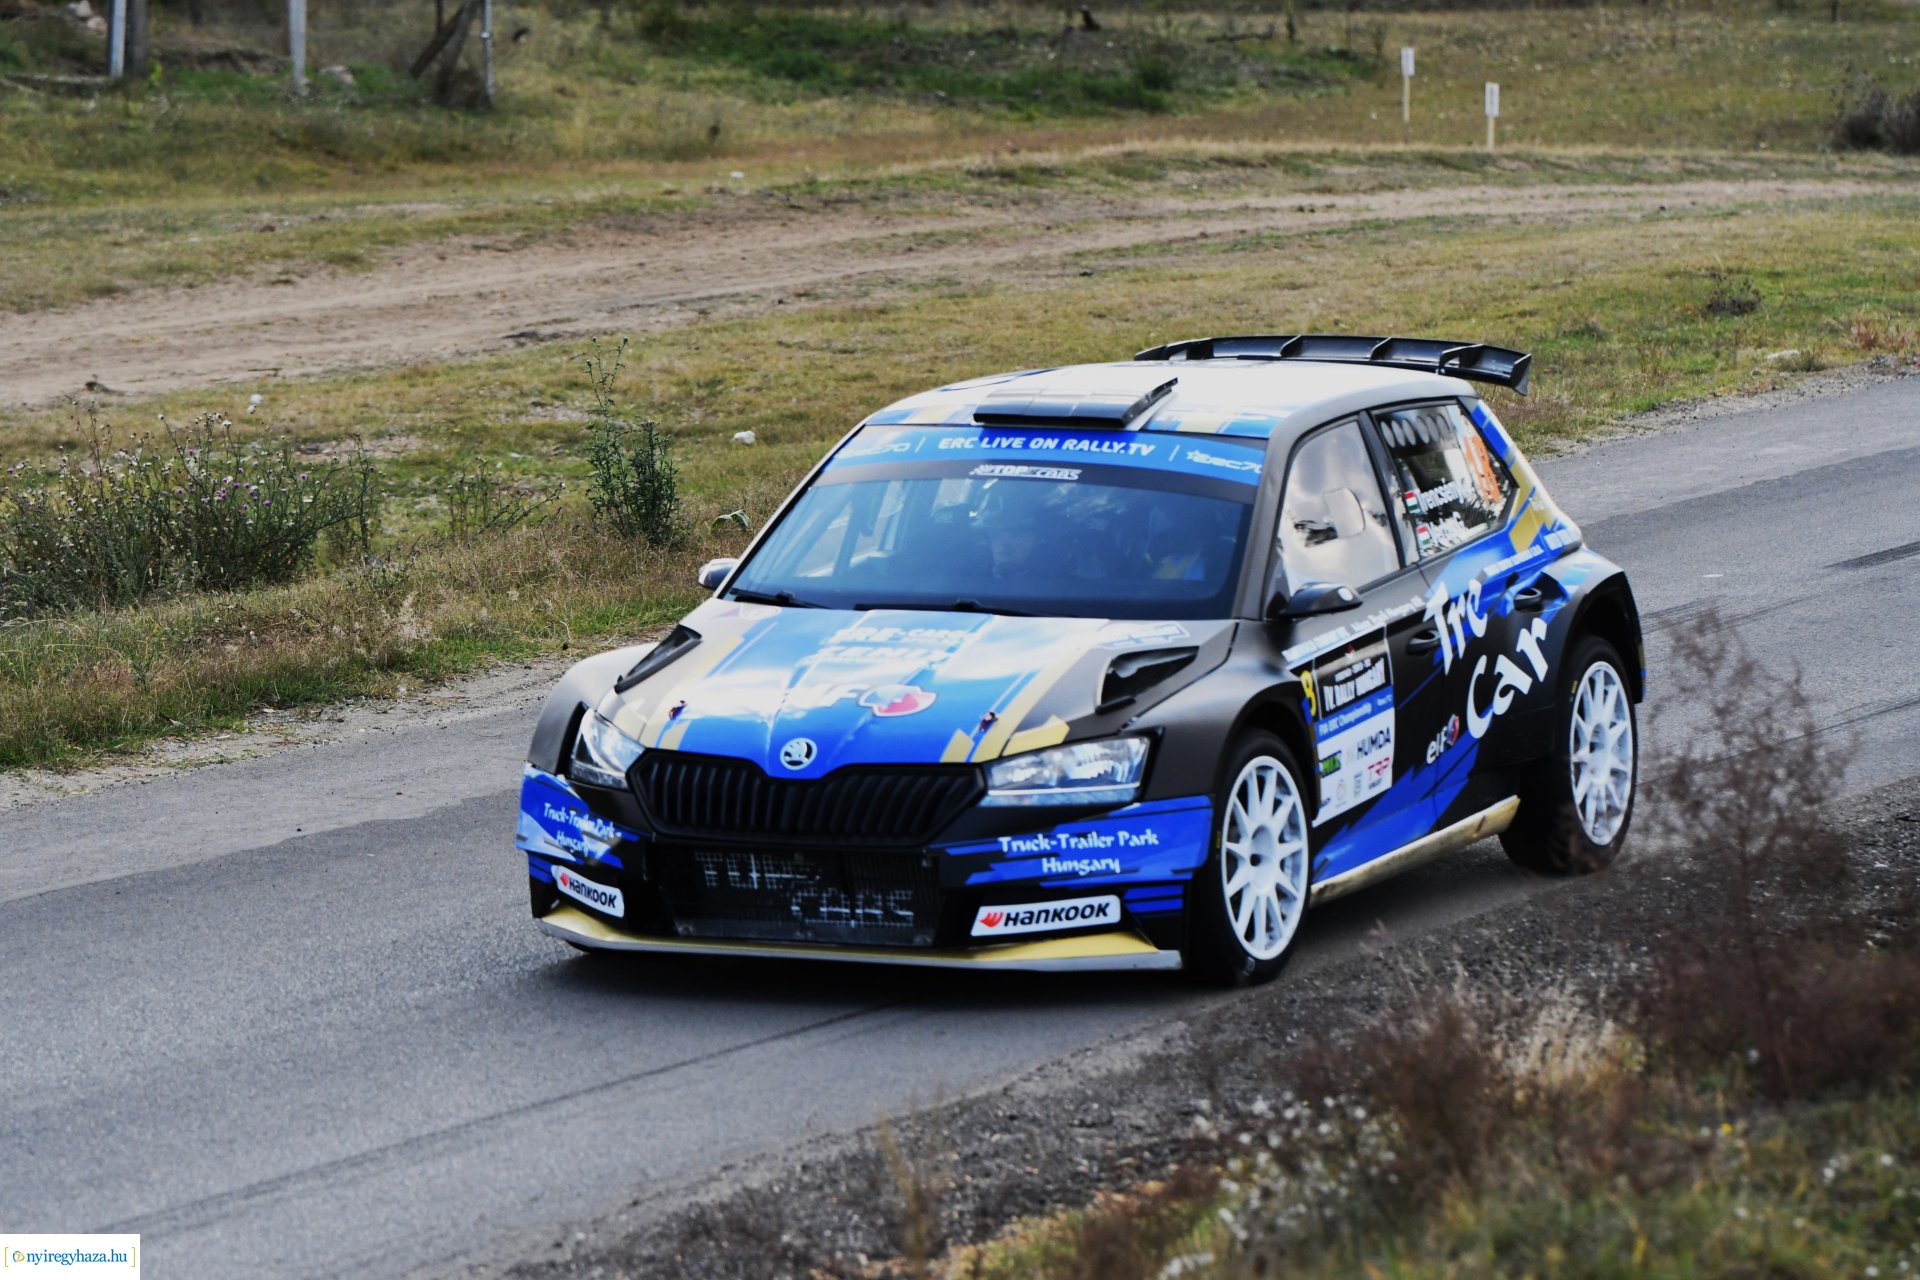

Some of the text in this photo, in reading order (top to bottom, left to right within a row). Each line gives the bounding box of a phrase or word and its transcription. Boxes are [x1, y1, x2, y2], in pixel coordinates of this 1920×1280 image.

[938, 437, 1156, 456] ERC LIVE ON RALLY.TV
[1467, 617, 1549, 739] Car
[1357, 726, 1391, 760] HUMDA
[998, 829, 1159, 852] Truck-Trailer Park
[1042, 857, 1121, 876] Hungary
